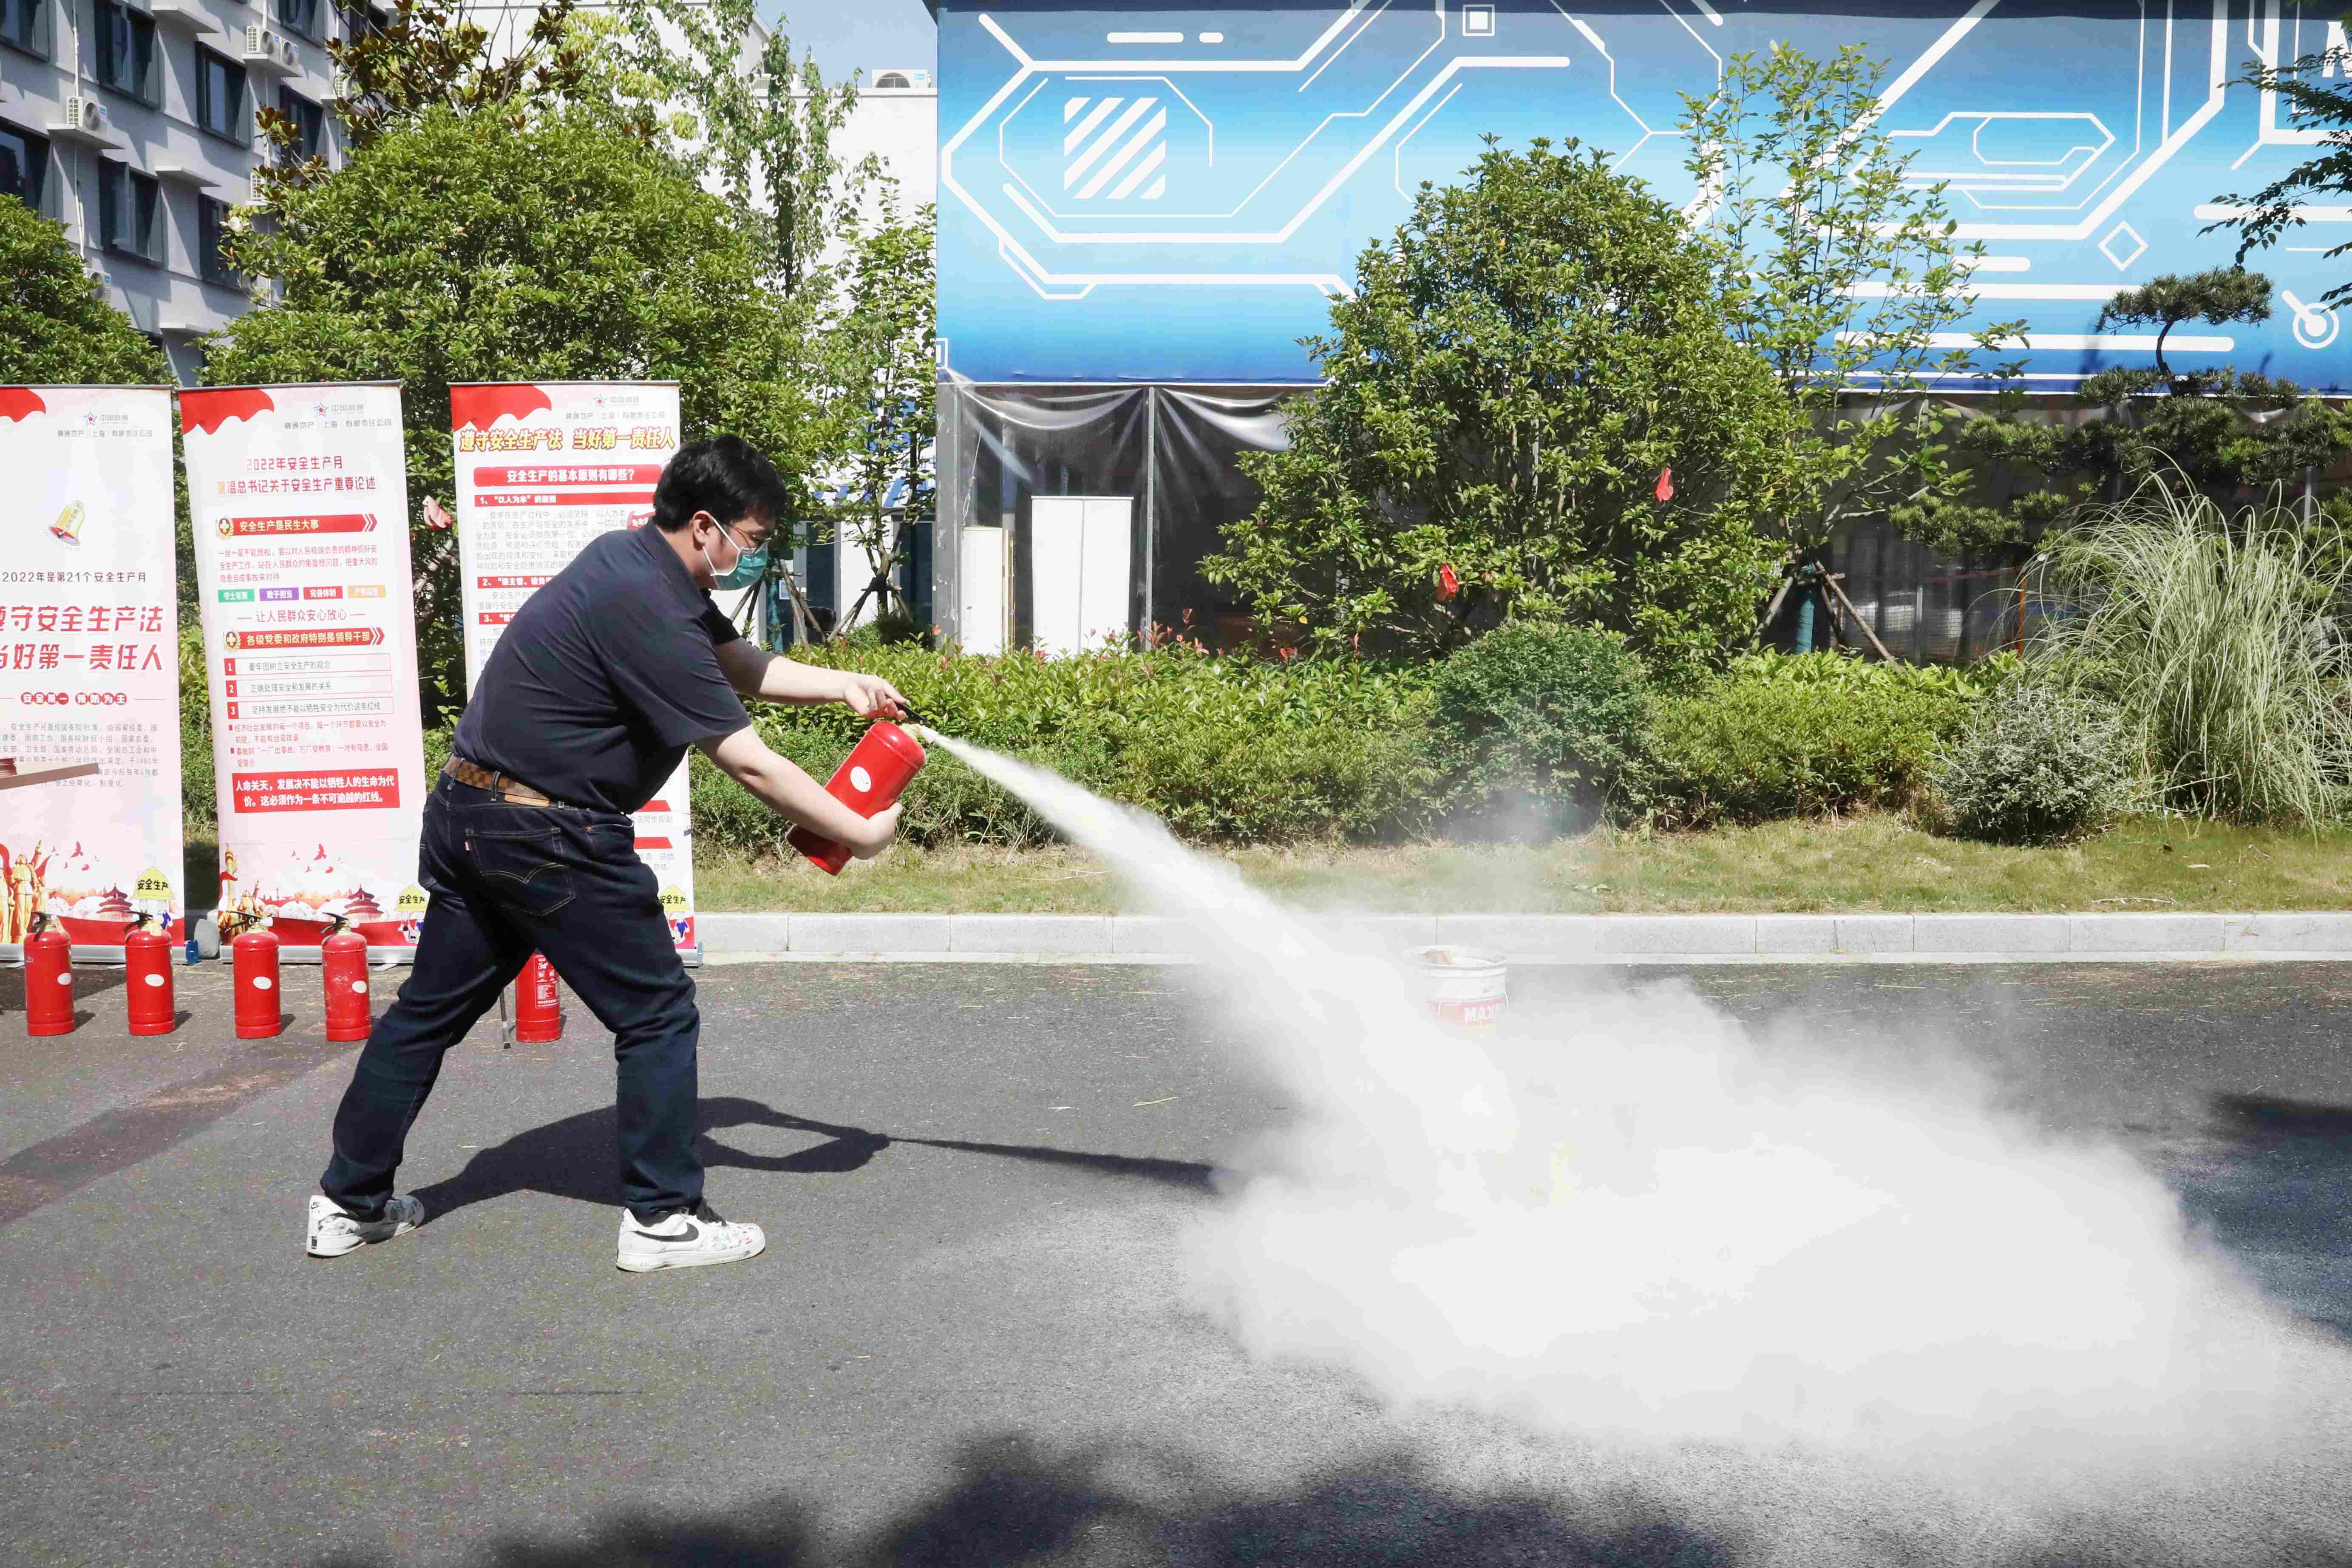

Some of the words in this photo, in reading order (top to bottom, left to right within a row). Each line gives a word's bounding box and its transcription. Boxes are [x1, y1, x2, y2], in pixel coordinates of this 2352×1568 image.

[459, 428, 563, 452] 遵守安全生产法
[572, 426, 675, 450] 当好第一责任人
[247, 456, 343, 471] 2022年安全生产月
[217, 476, 376, 494] 重温总书记关于安全生产重要论述
[239, 519, 319, 532] 安全生产是民生大事
[3, 572, 146, 583] 2022年是第21个安全生产月
[256, 609, 347, 622] 让人民群众安心放心
[247, 632, 370, 646] 各级党委和政府特别是领导干部
[228, 663, 232, 672] 1
[229, 684, 234, 693] 2
[250, 682, 332, 693] 正确处理安全和发展的关系
[231, 706, 235, 715] 3
[137, 879, 169, 891] 安全生产
[399, 896, 425, 905] 安全生产
